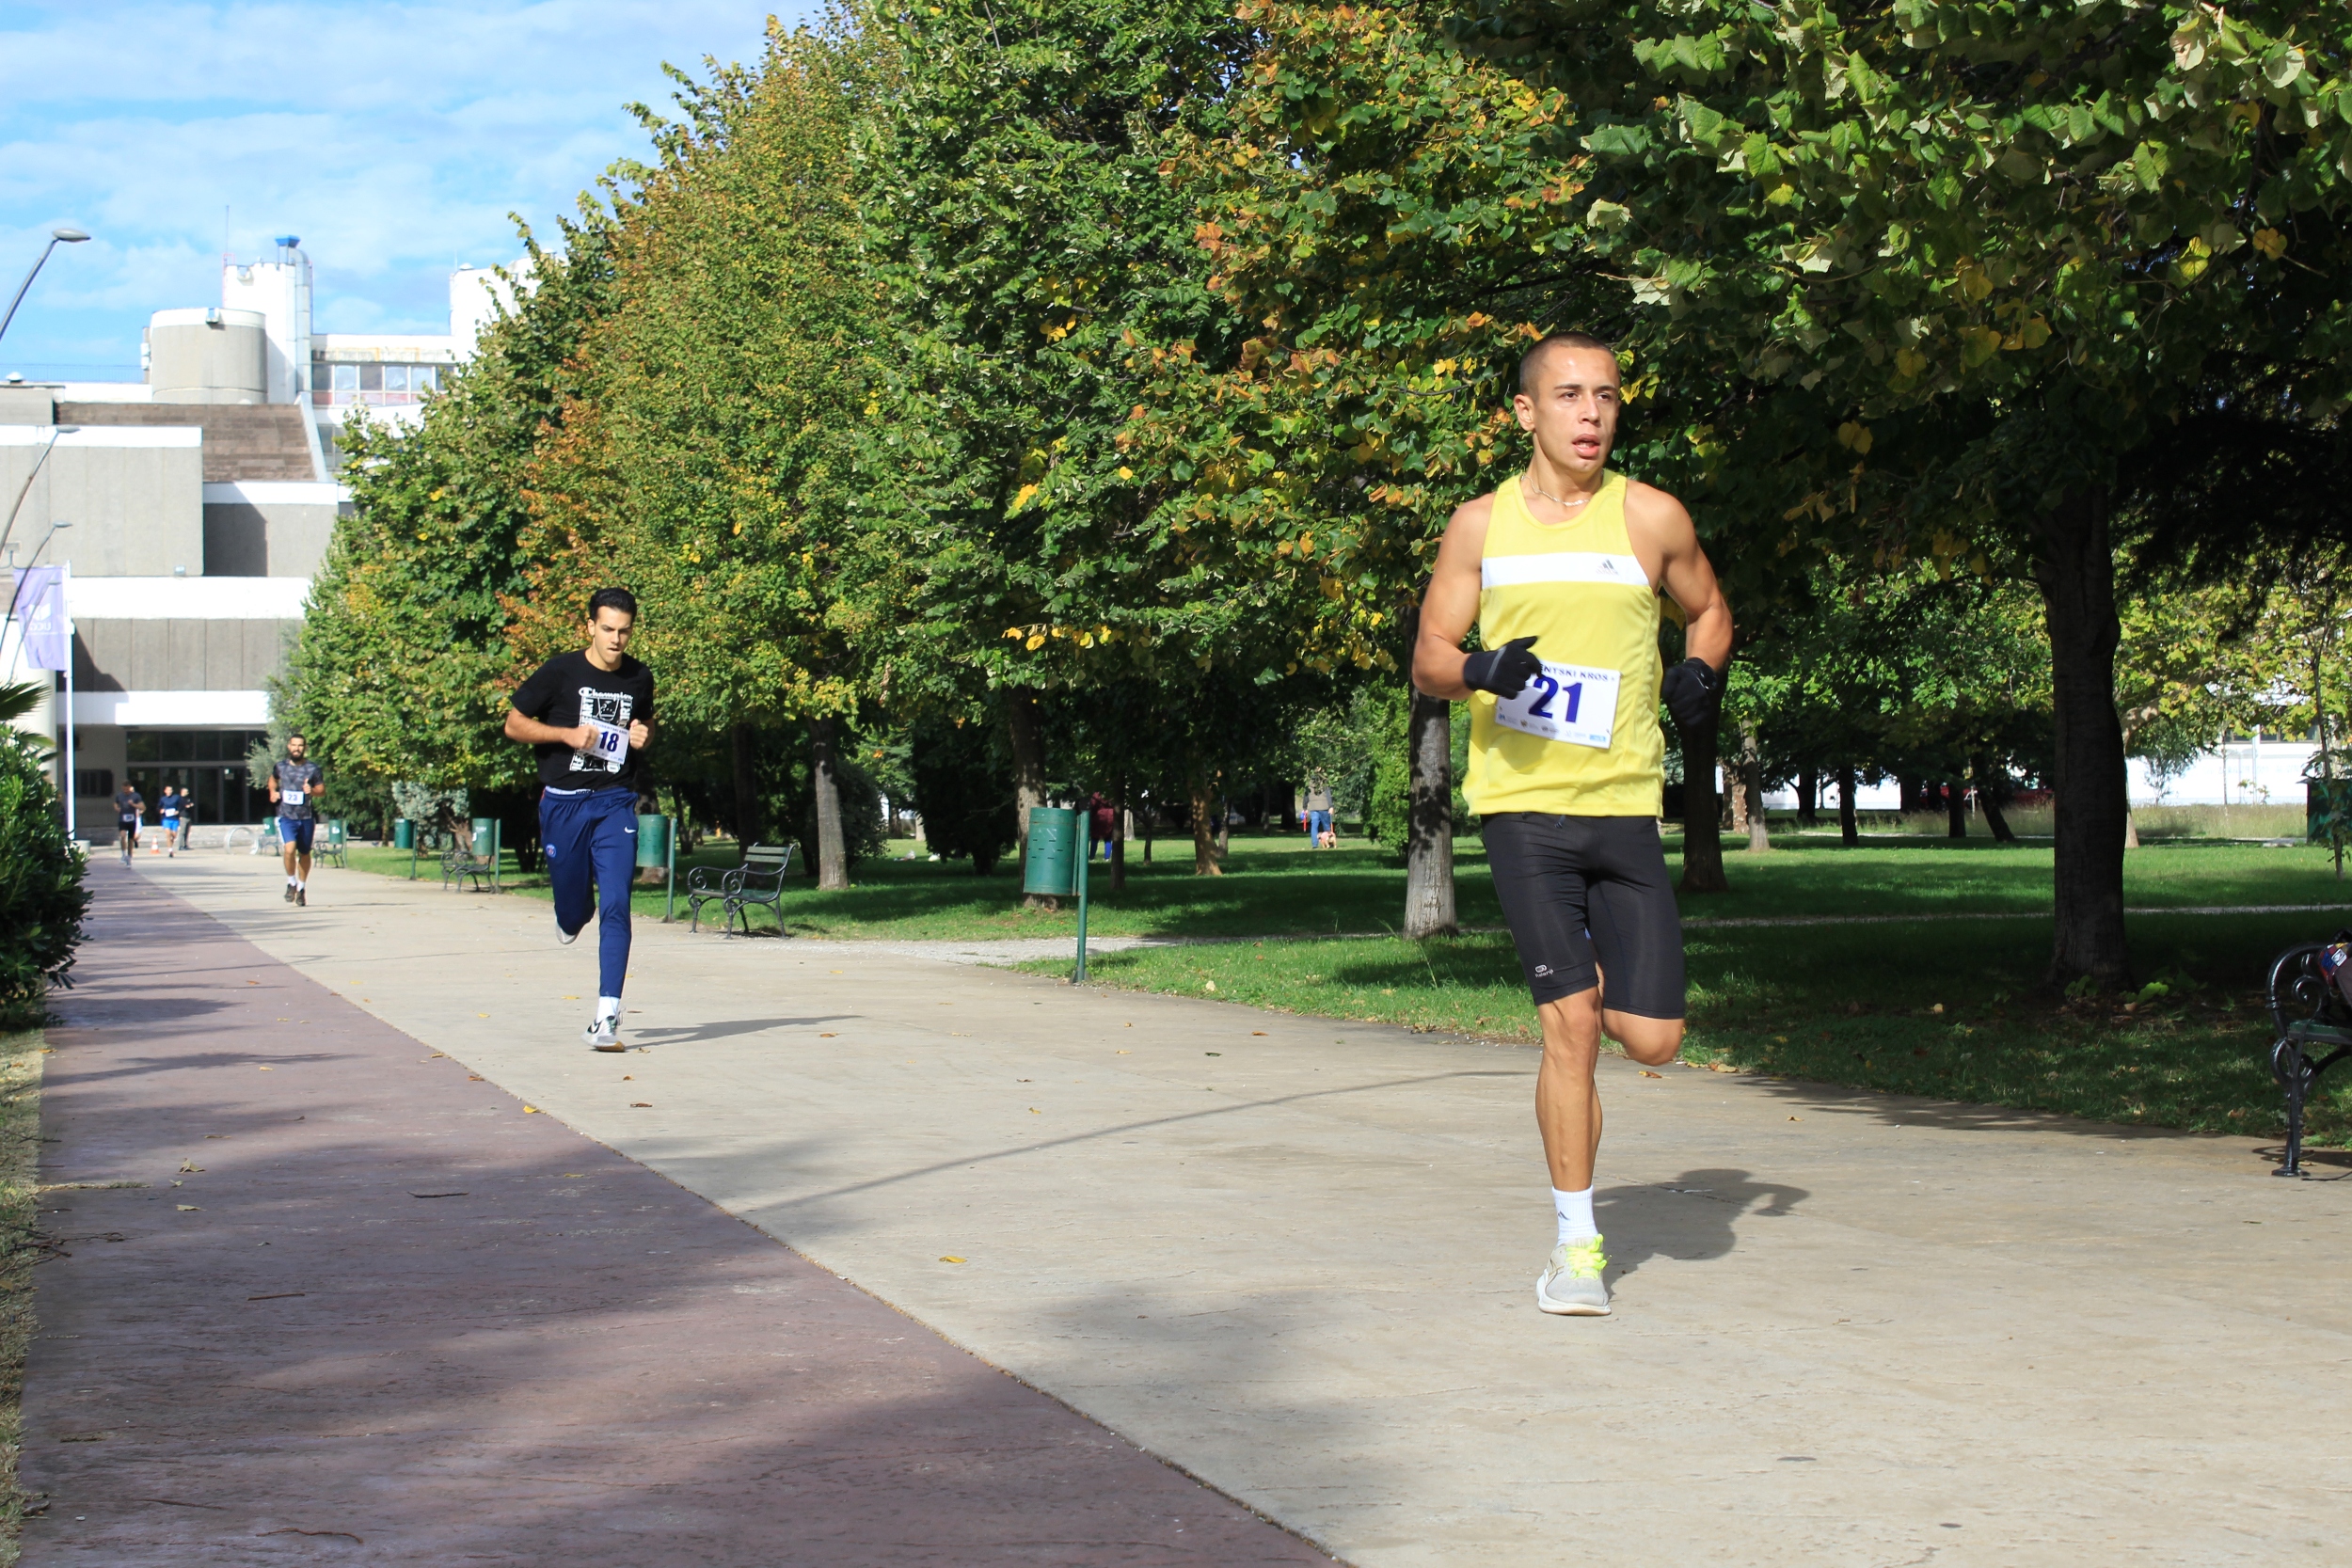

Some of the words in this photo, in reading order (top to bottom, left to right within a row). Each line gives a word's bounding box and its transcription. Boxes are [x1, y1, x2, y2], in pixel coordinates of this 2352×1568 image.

[1580, 671, 1609, 682] KROS
[579, 686, 633, 702] Champion
[1529, 674, 1582, 723] 21
[599, 731, 619, 752] 18
